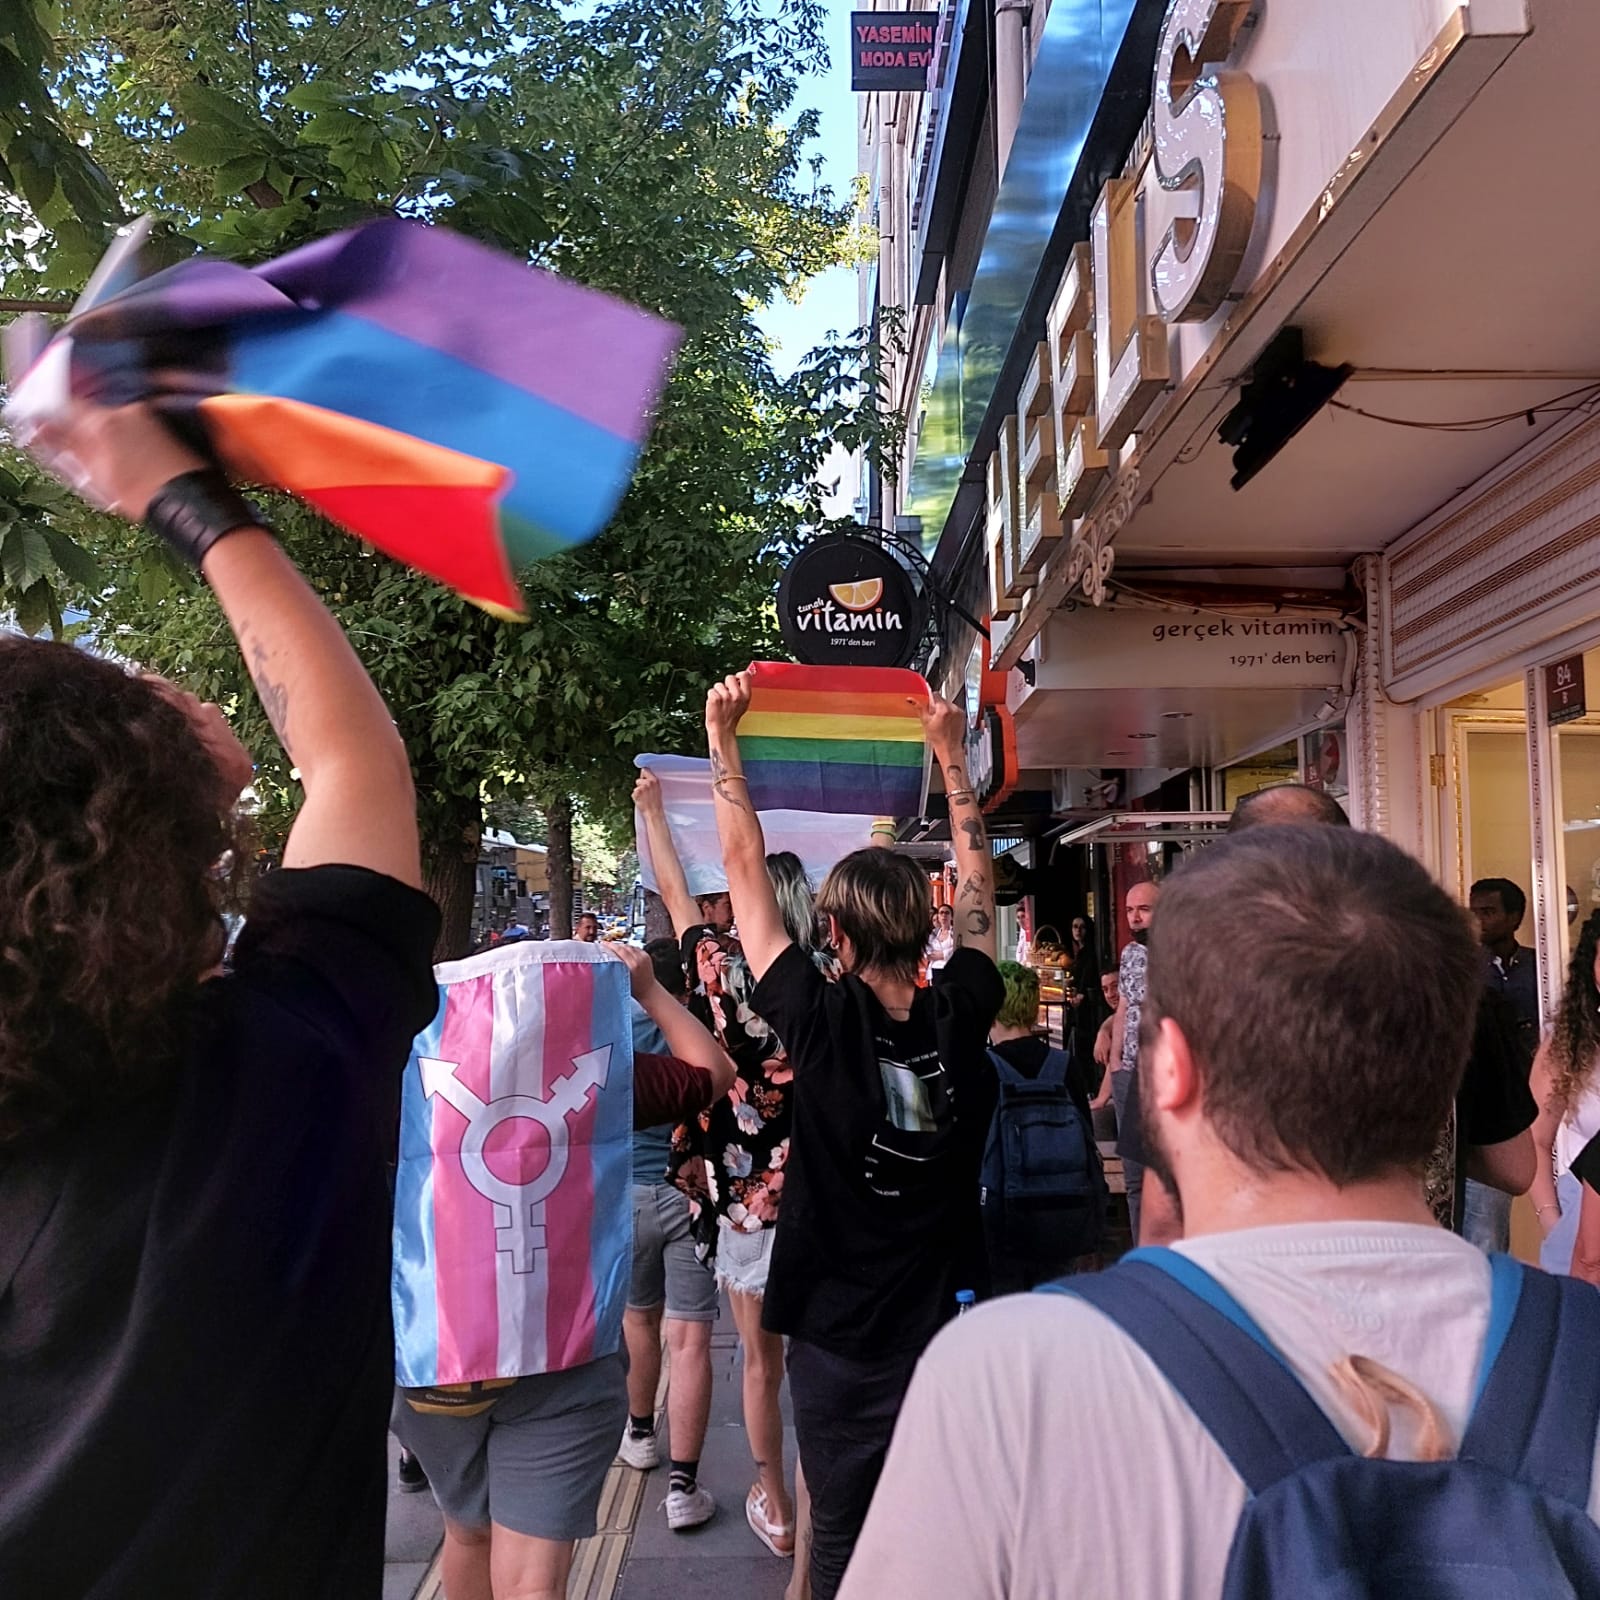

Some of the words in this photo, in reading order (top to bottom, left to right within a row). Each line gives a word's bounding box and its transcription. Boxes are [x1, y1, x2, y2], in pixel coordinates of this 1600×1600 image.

[857, 22, 932, 43] YASEMİN
[861, 51, 905, 67] MODA
[797, 600, 902, 632] vitamin
[1152, 619, 1234, 641] gerçek
[1240, 618, 1333, 636] vitamin
[1271, 651, 1301, 665] den
[1305, 650, 1336, 665] beri
[1557, 664, 1571, 685] 84
